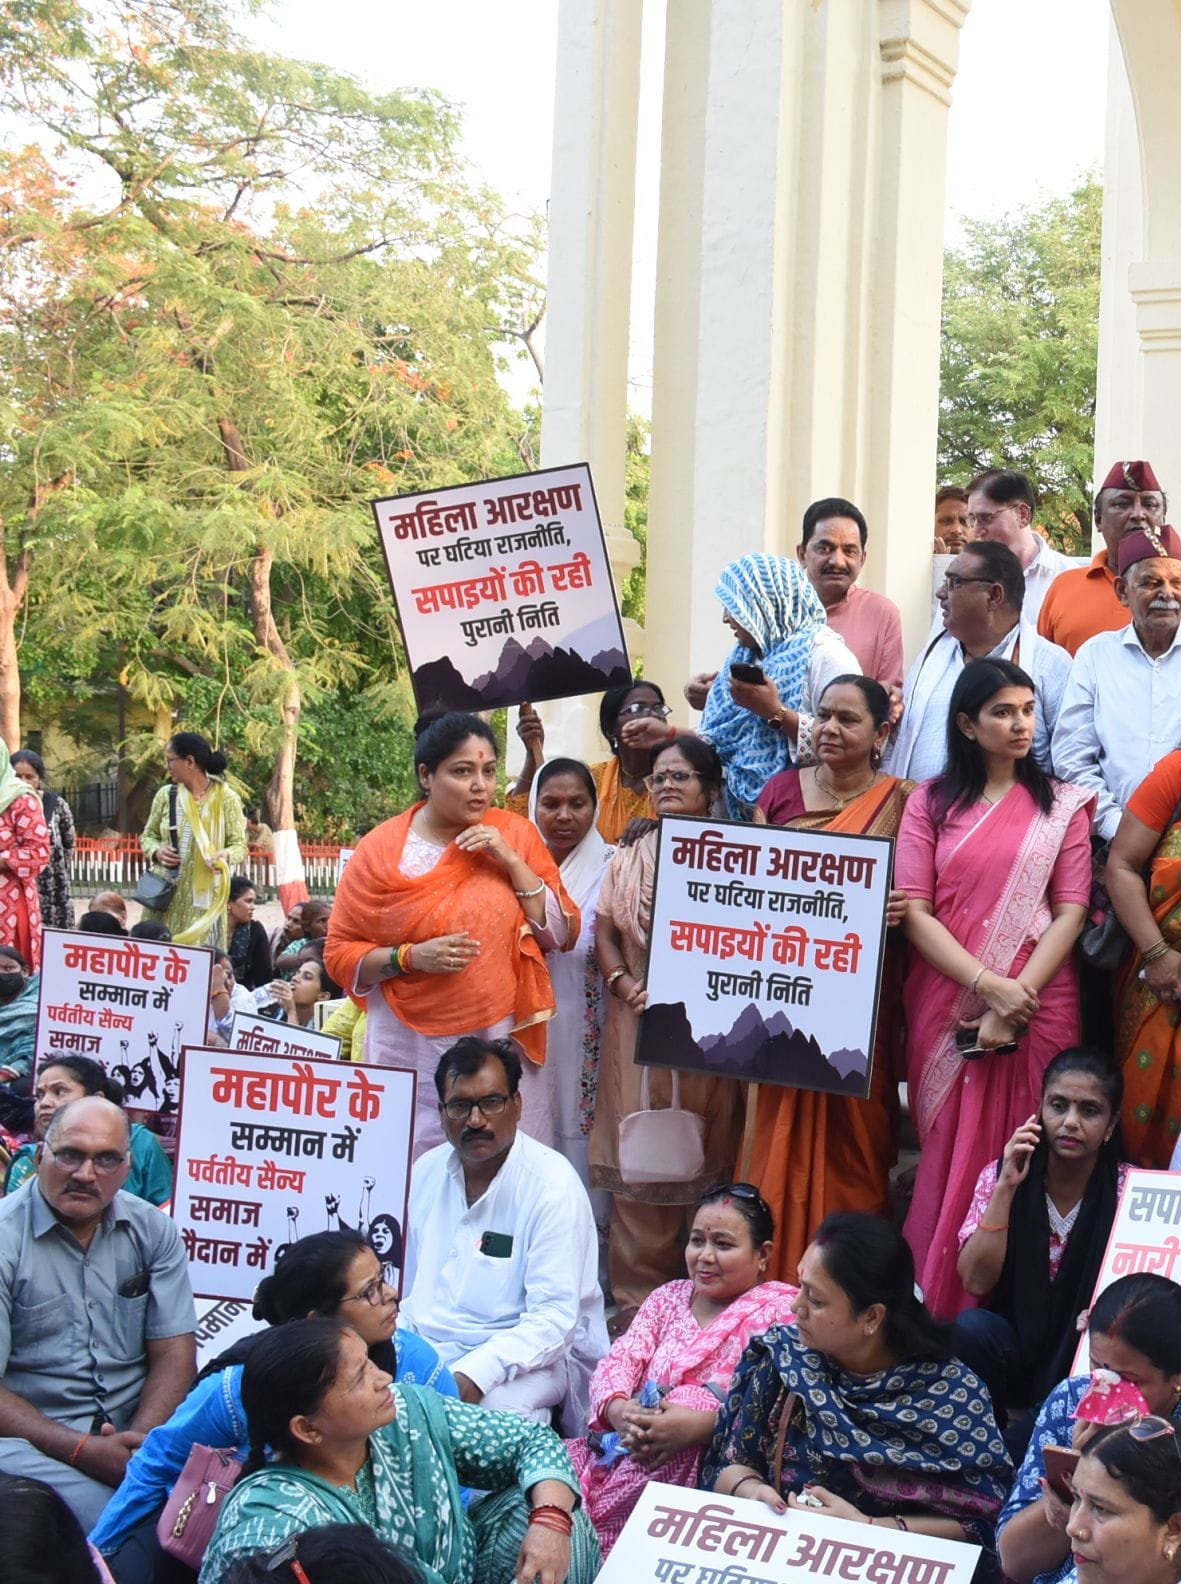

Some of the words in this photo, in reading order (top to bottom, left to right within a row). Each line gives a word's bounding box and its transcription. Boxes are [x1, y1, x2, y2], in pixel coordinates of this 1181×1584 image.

[389, 501, 478, 540] महिला
[484, 483, 583, 525] आरक्षण
[416, 546, 441, 567] पर
[443, 537, 493, 564] घटिया
[493, 521, 571, 555] राजनीति,
[411, 566, 507, 614] सपाइयों
[509, 560, 546, 597] की
[547, 551, 593, 591] रही
[460, 608, 515, 647] पुरानी
[517, 601, 561, 632] निति
[671, 830, 761, 876] महिला
[766, 847, 877, 890] आरक्षण
[687, 880, 711, 903] पर
[714, 880, 765, 910] घटिया
[768, 889, 849, 924] राजनीति,
[63, 942, 159, 981] महापौर
[164, 949, 190, 985] के
[669, 920, 772, 962] सपाइयों
[771, 925, 810, 967] की
[813, 932, 863, 974] रही
[78, 981, 149, 1008] सम्मान
[152, 986, 174, 1012] में
[705, 970, 763, 1001] पुरानी
[766, 972, 813, 1007] निति
[47, 1003, 95, 1026] पर्वतीय
[98, 1008, 134, 1031] सैन्य
[49, 1031, 102, 1053] समाज
[210, 1062, 341, 1118] महापौर
[347, 1069, 384, 1122] के
[230, 1122, 327, 1159] सम्मान
[332, 1125, 361, 1163] में
[187, 1154, 253, 1187] पर्वतीय
[257, 1160, 306, 1193] सैन्य
[189, 1195, 262, 1227] समाज
[246, 1237, 272, 1270] में
[1112, 1236, 1181, 1278] नारी
[647, 1504, 788, 1563] महिला
[787, 1534, 955, 1584] आरक्षण
